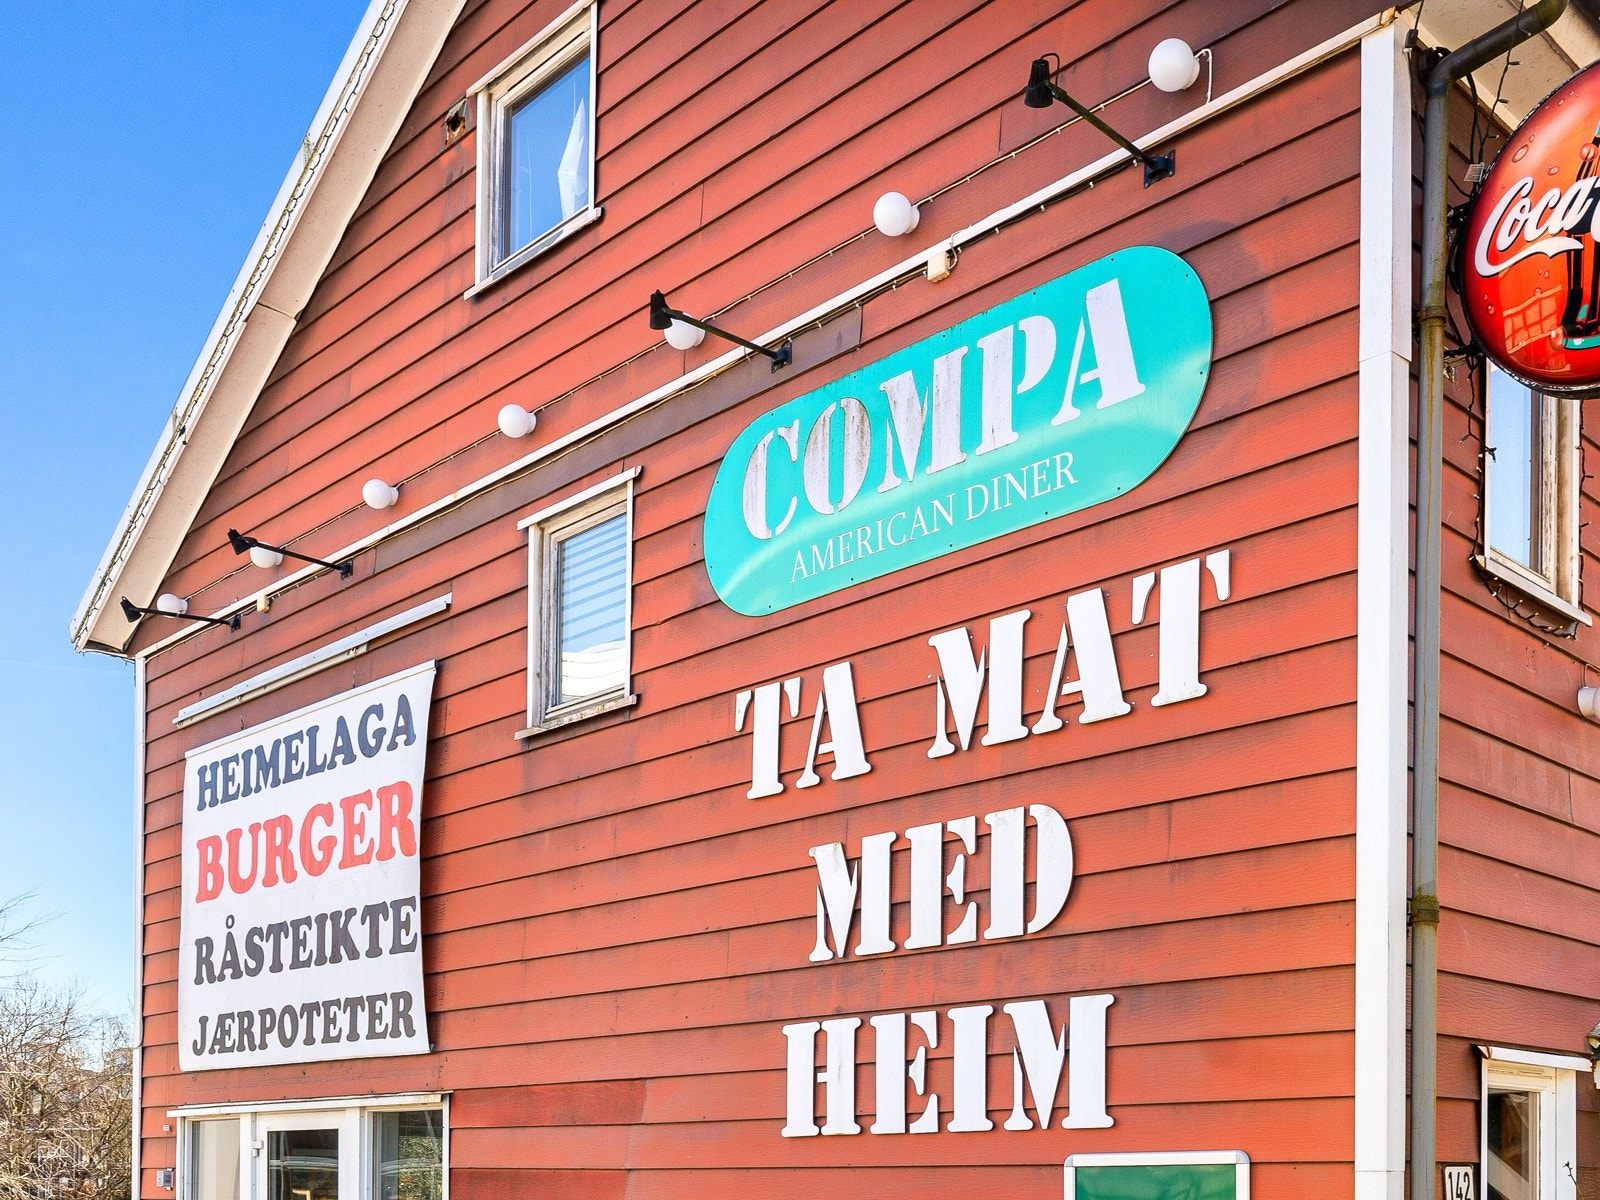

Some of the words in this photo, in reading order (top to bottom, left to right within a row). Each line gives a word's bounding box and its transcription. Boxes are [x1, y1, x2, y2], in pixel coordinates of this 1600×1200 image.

[1475, 176, 1600, 277] Coca
[741, 277, 1146, 541] COMPA
[788, 499, 955, 584] AMERICAN
[965, 451, 1078, 523] DINER
[735, 660, 872, 800] TA
[927, 548, 1231, 759] MAT
[197, 693, 417, 812] HEIMELAGA
[195, 780, 418, 904] BURGER
[808, 803, 1074, 962] MED
[194, 895, 418, 986] RÅSTEIKTE
[192, 991, 416, 1057] JÆRPOTETER
[780, 993, 1115, 1138] HEIM
